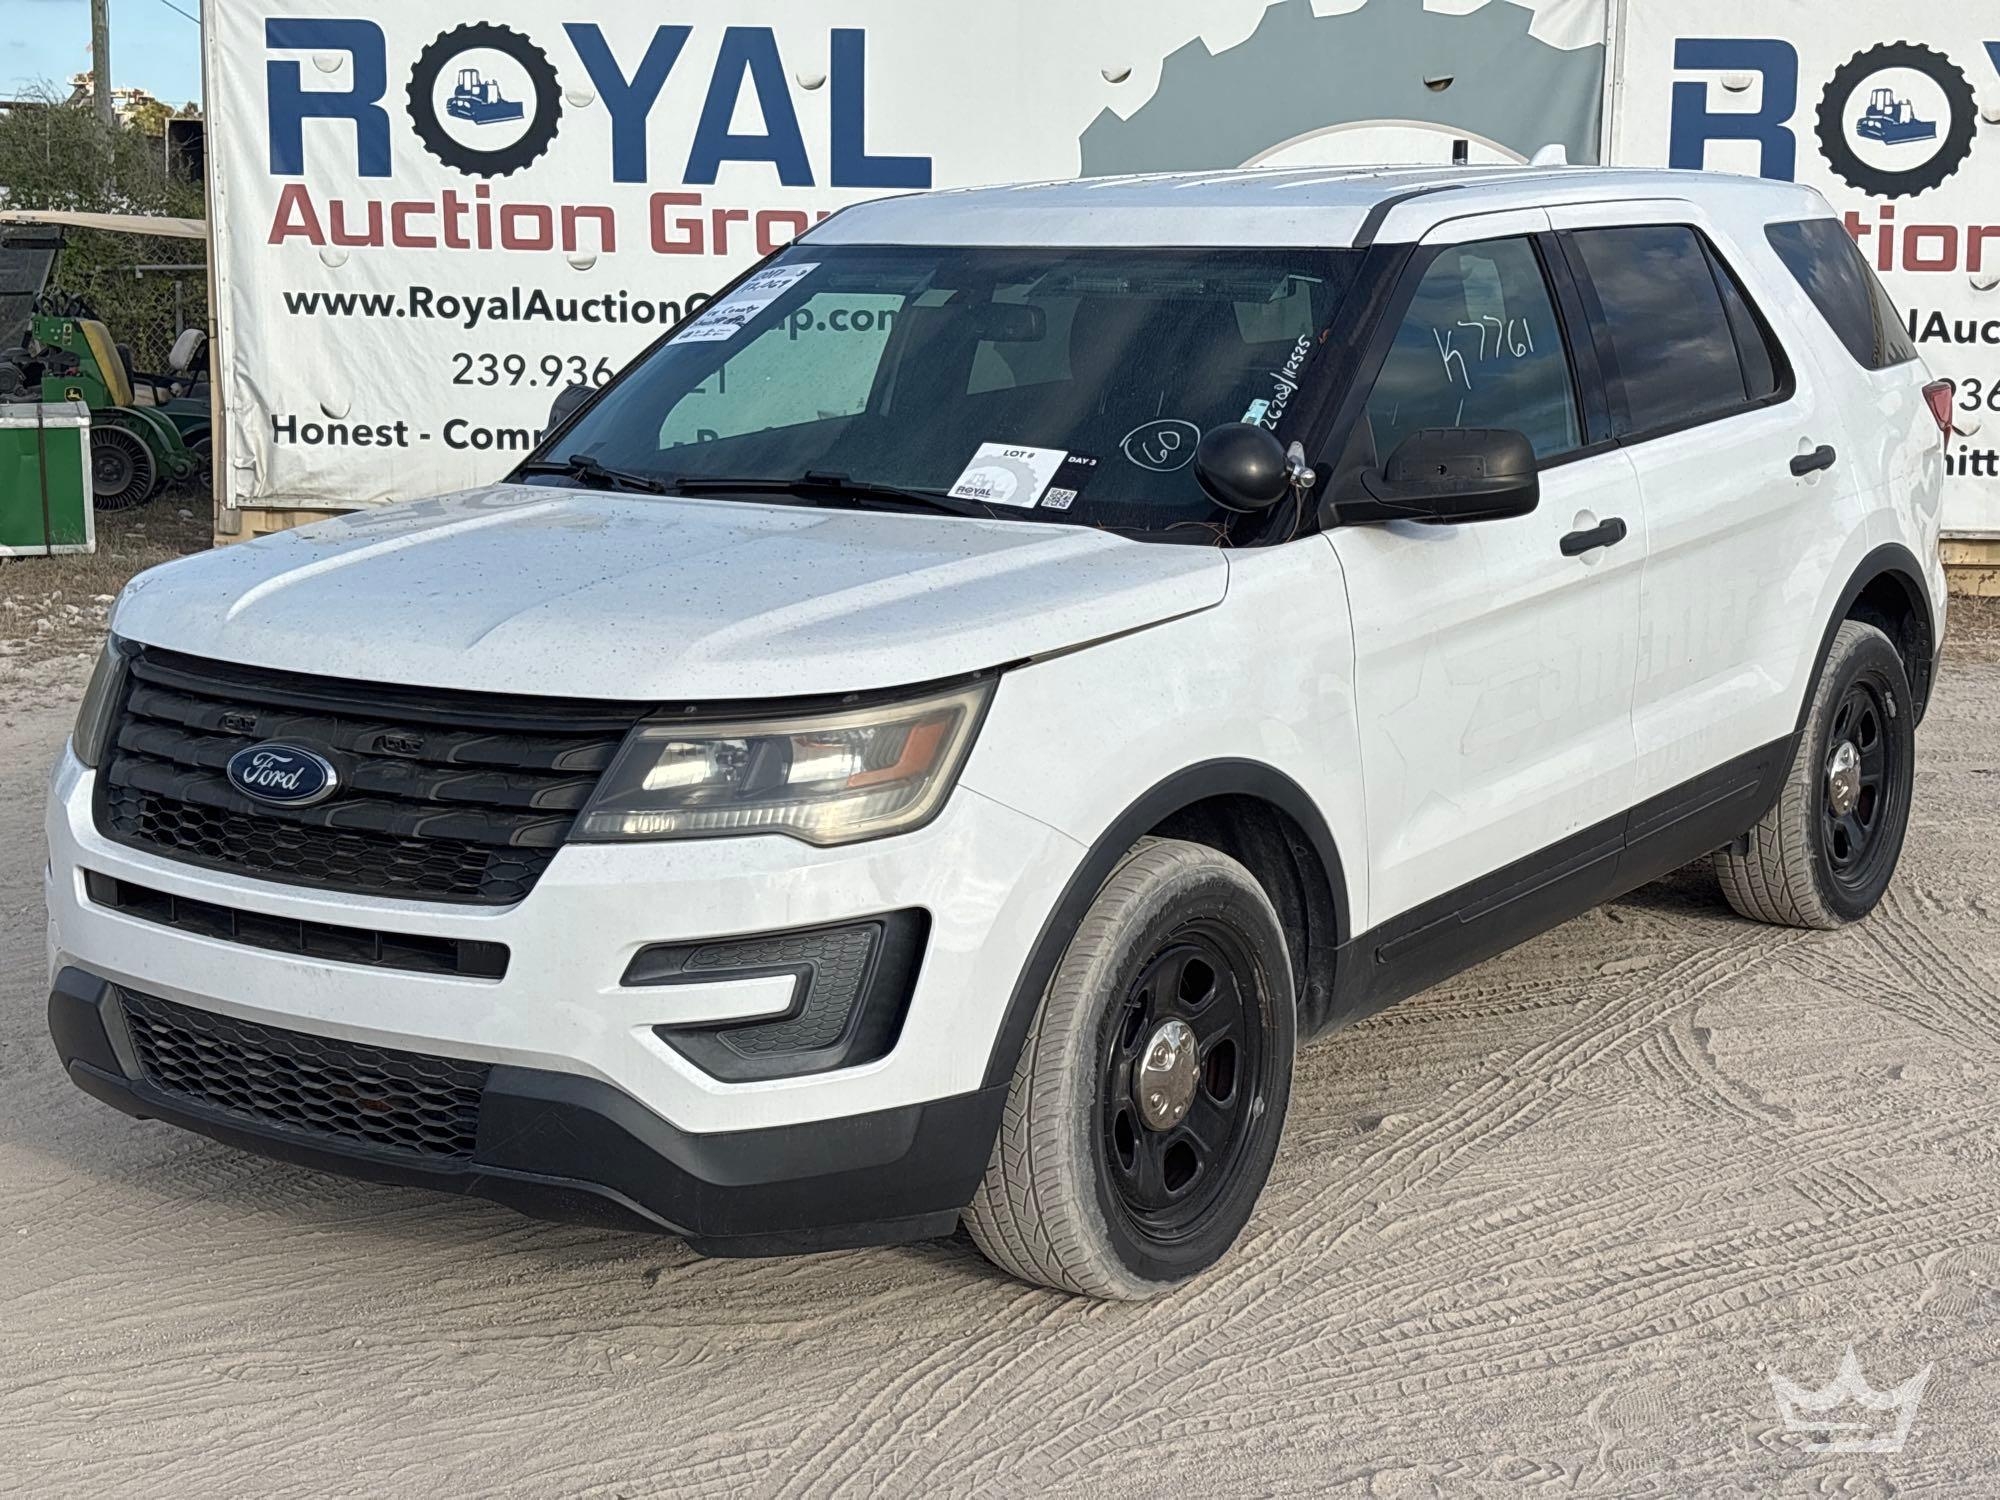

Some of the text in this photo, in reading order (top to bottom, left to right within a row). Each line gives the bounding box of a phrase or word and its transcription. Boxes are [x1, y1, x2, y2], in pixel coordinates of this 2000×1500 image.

[265, 17, 932, 189] ROYAL
[268, 184, 831, 256] Auction Gro
[271, 414, 409, 448] Honest
[1003, 449, 1027, 458] LOT
[1067, 456, 1089, 465] DAY
[954, 485, 992, 496] ROYAL
[243, 752, 305, 790] Ford
